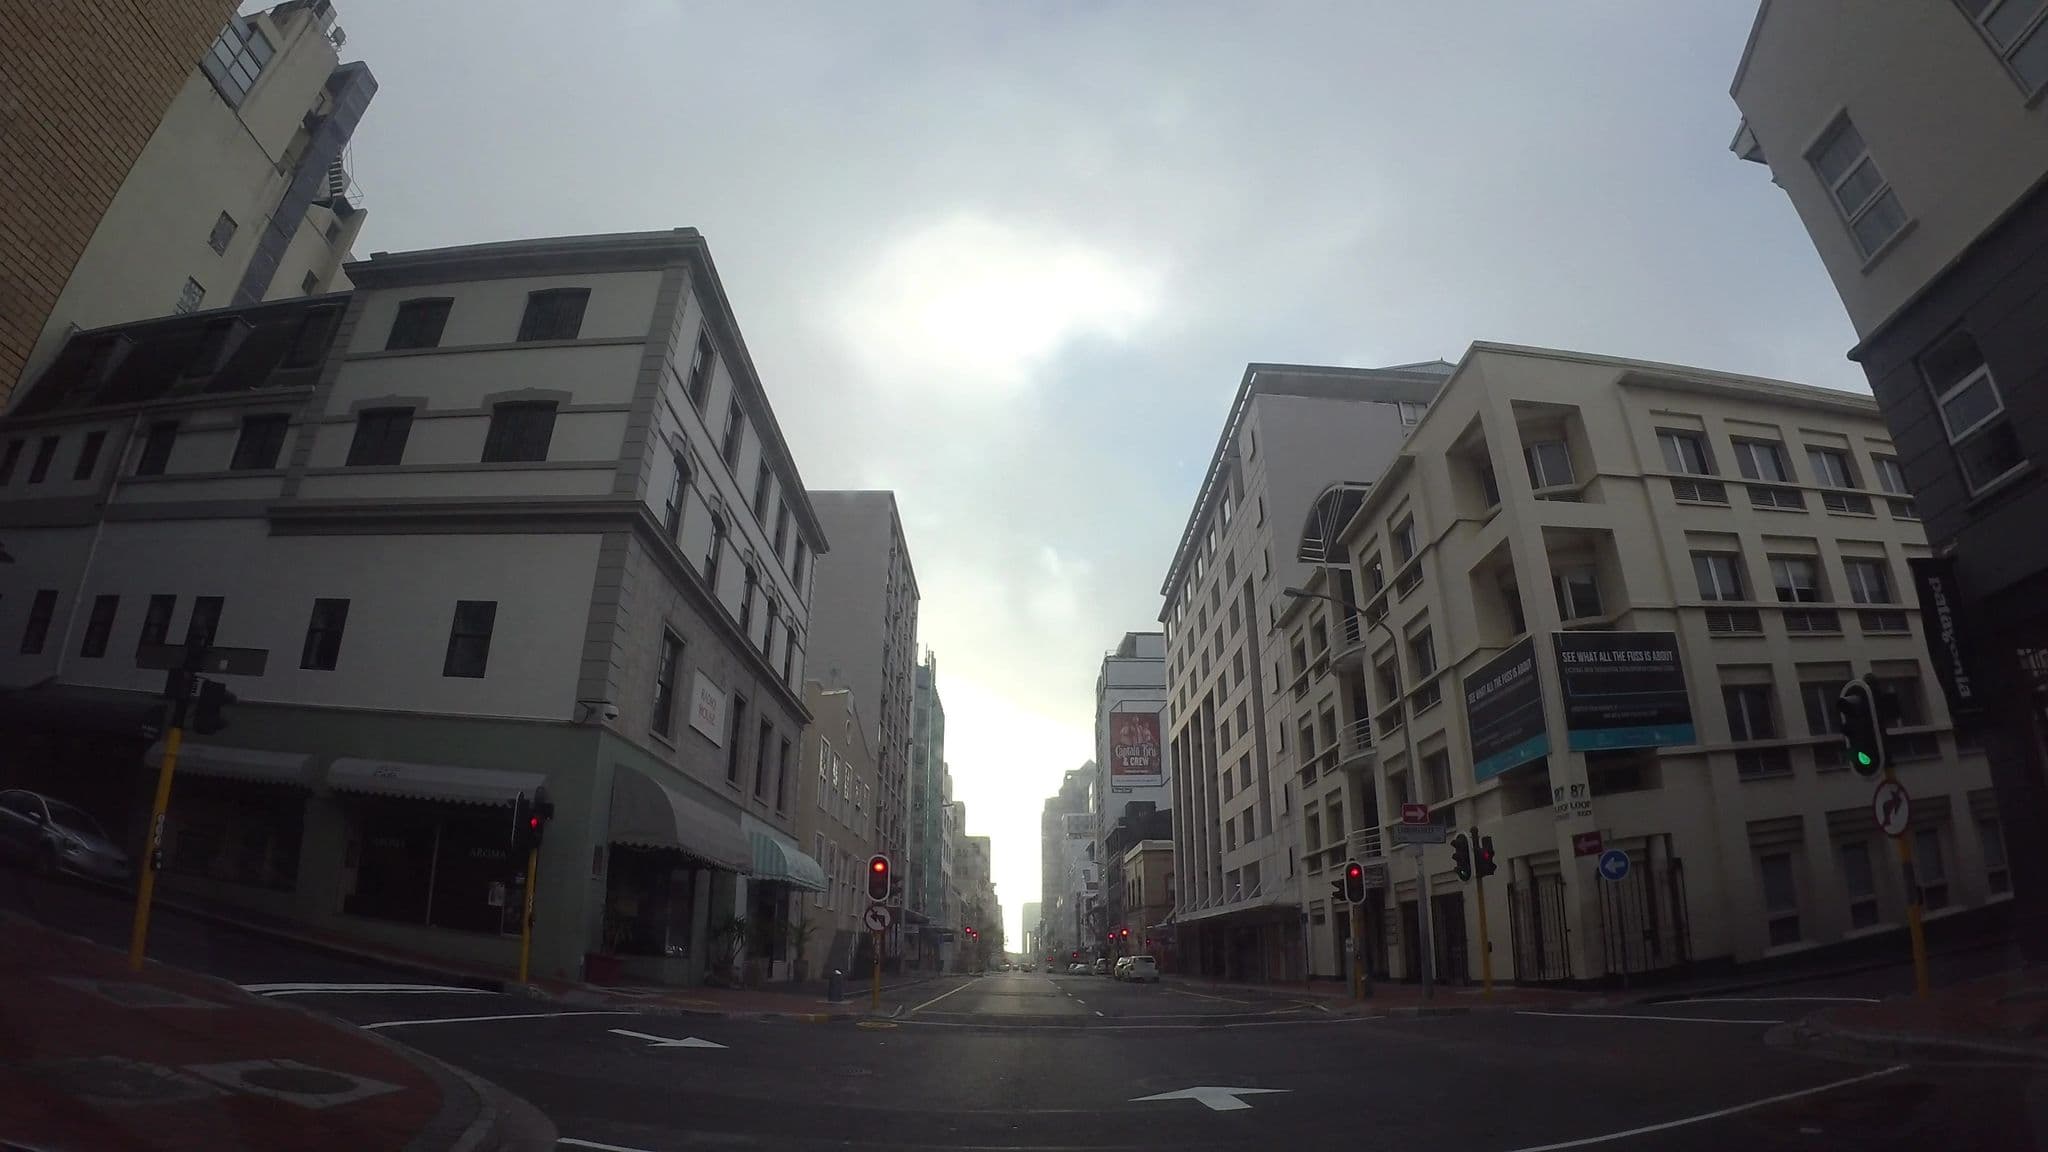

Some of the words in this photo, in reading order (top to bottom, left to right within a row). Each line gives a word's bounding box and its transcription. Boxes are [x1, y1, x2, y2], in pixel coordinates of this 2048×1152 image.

[1928, 577, 1972, 698] patagonia
[1562, 651, 1576, 662] SEE
[1576, 651, 1598, 662] WHAT
[1599, 651, 1612, 662] ALL
[1612, 651, 1626, 661] THE
[1626, 651, 1643, 661] FUSS
[1644, 651, 1651, 661] IS
[1652, 651, 1673, 661] ABOUT
[1493, 676, 1502, 688] THE
[1502, 670, 1513, 684] FUSS
[1130, 756, 1149, 766] CREW
[1570, 783, 1585, 798] 87
